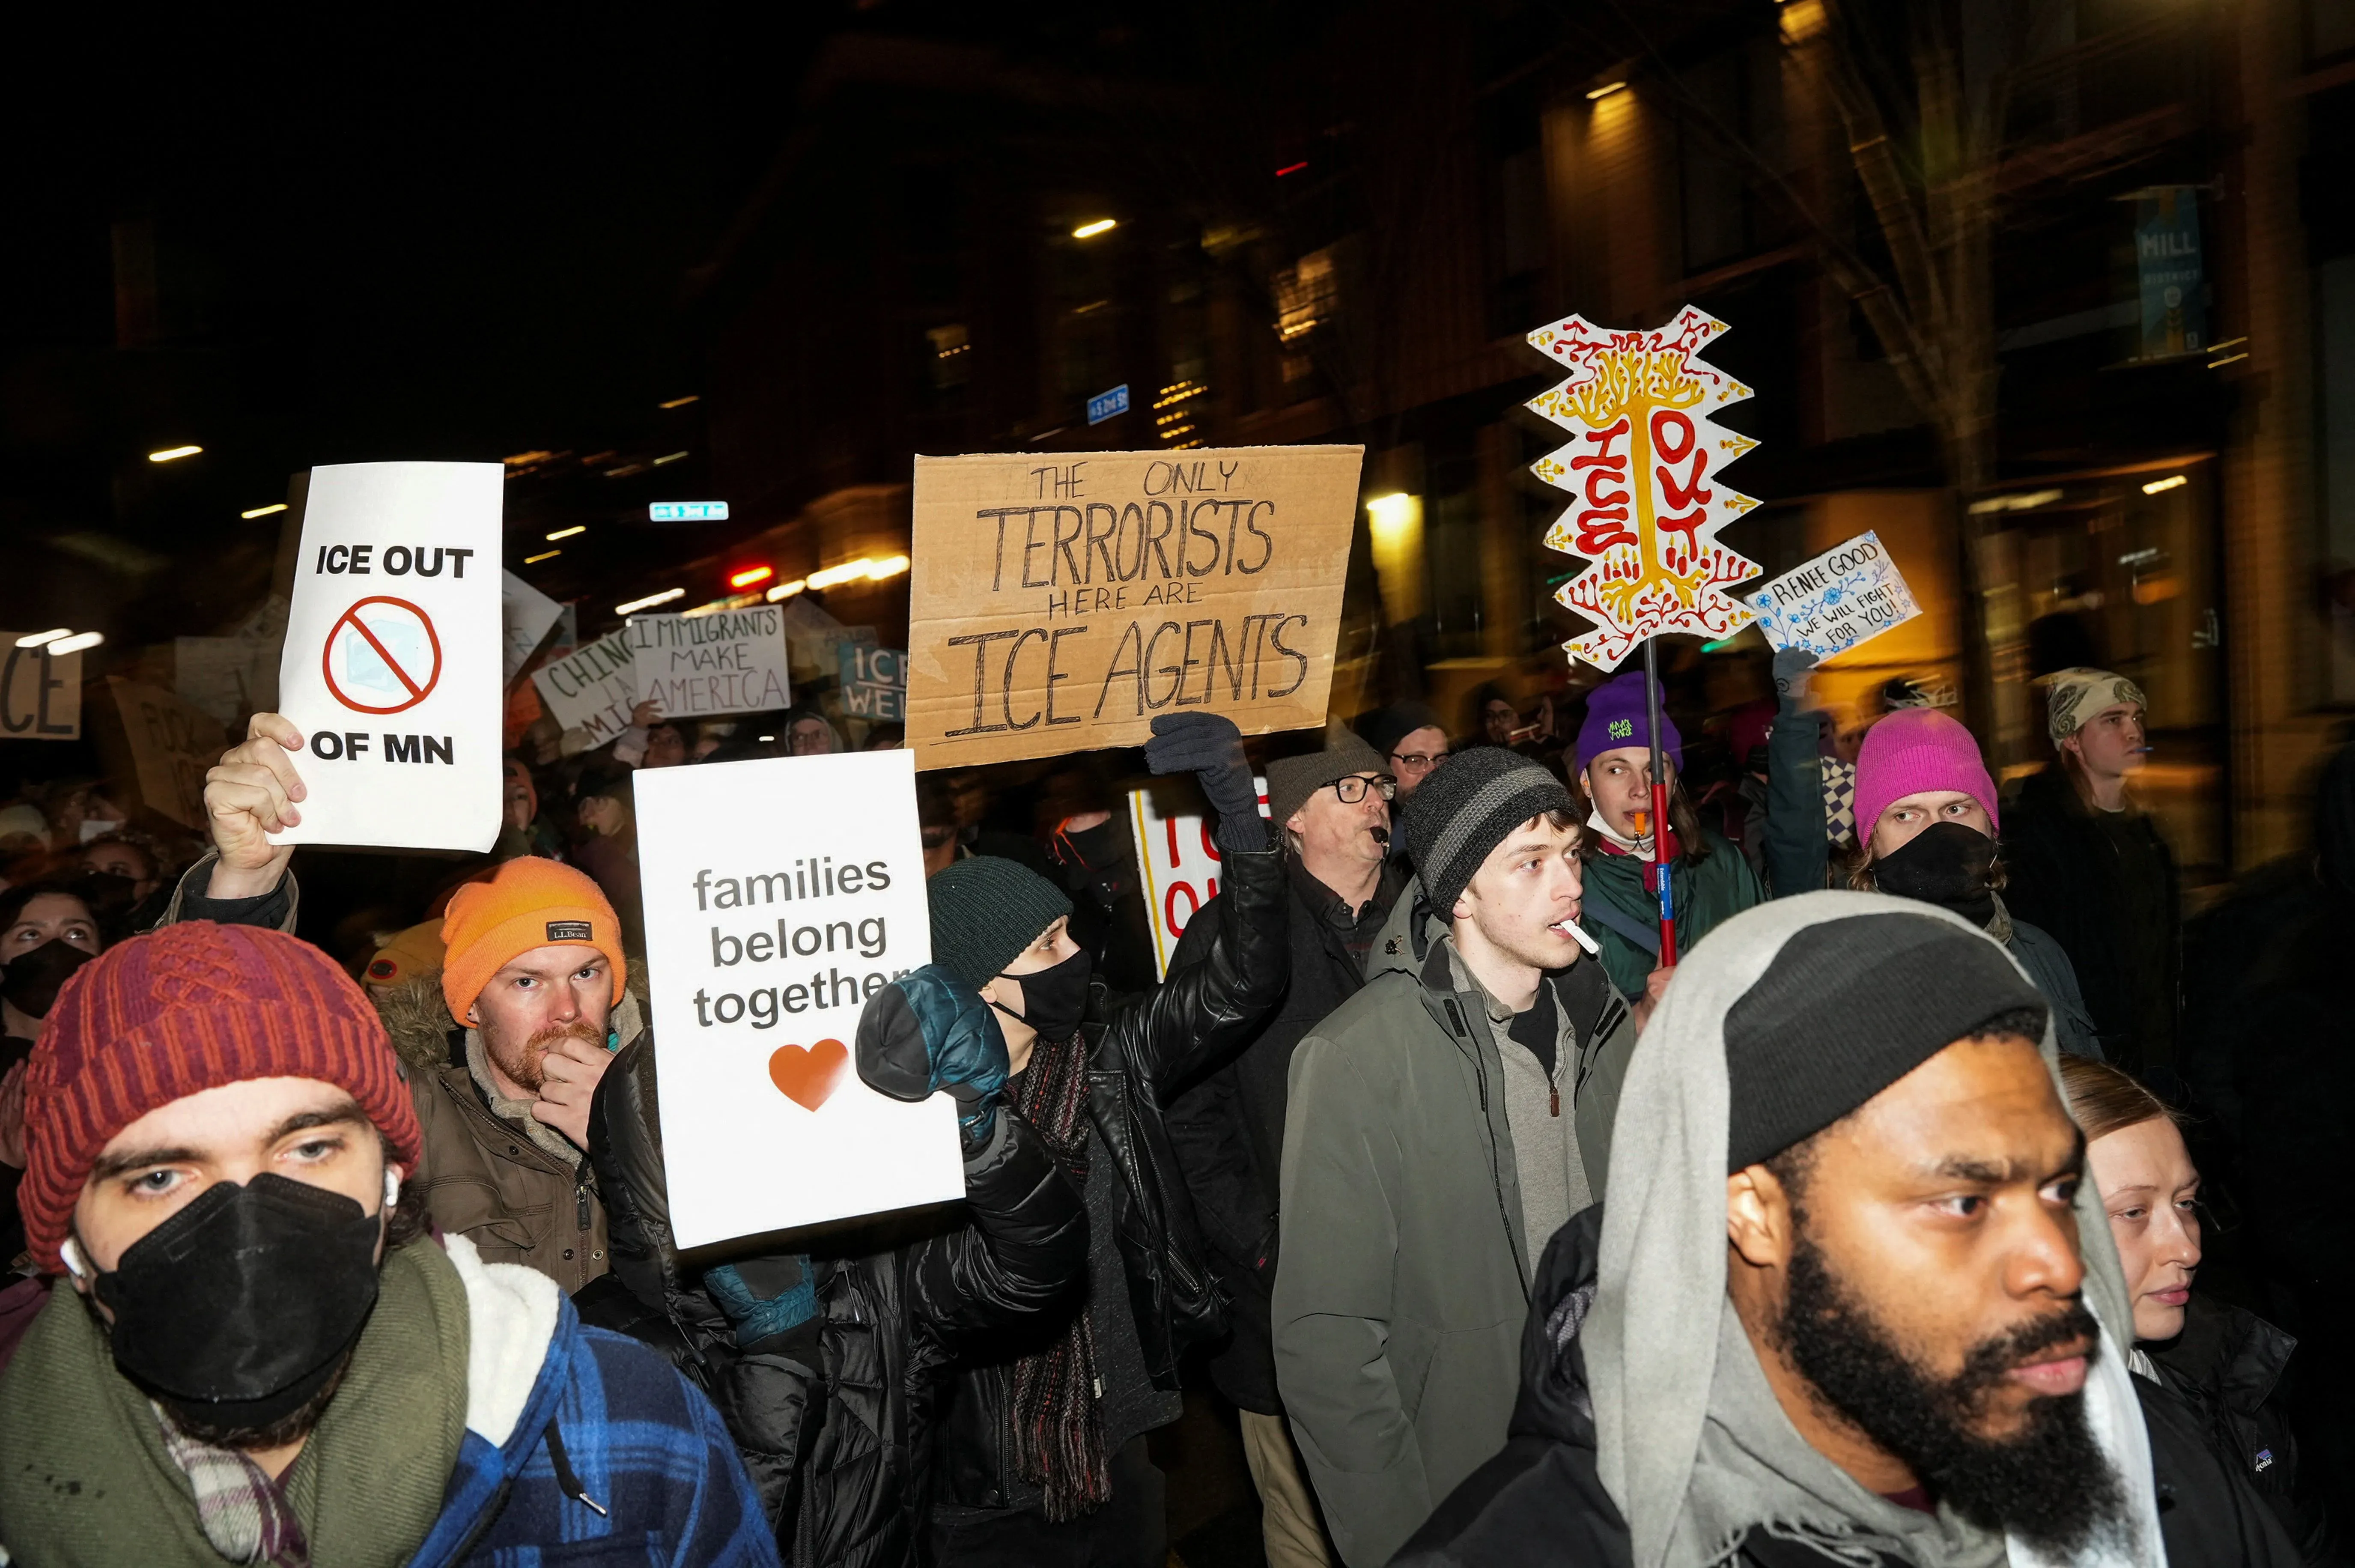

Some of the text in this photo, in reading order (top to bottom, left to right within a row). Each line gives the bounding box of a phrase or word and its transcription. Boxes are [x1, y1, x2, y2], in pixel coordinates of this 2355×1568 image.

[2141, 231, 2197, 257] MILL
[1031, 461, 1238, 499] THE ONLY
[316, 545, 474, 578] ICE OUT
[976, 499, 1275, 591] TERRORISTS
[1772, 543, 1878, 605] RENEE GOOD
[1049, 581, 1204, 620] HERE ARE
[1797, 583, 1895, 637] WE WILL FIGHT
[1826, 600, 1899, 645] FOR YOU!
[633, 609, 777, 648] IMMIGRANTS
[671, 643, 755, 673] MAKE
[945, 613, 1308, 737] ICE AGENTS
[648, 669, 787, 714] AMERICA
[311, 731, 454, 765] OF MN
[693, 856, 891, 911] families
[711, 916, 887, 968] belong
